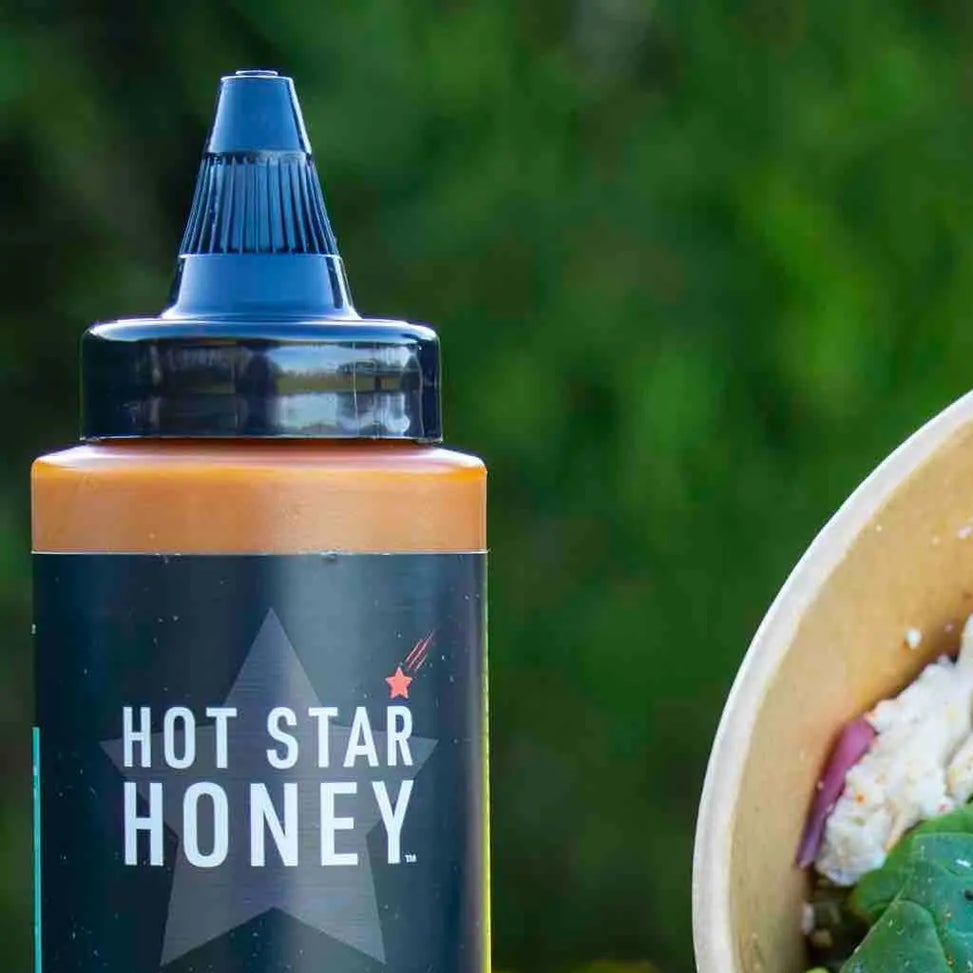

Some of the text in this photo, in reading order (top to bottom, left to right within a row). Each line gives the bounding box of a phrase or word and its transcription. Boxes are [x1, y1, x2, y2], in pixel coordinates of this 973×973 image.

[123, 706, 414, 769] HOT STAR
[123, 780, 414, 867] HONEY
